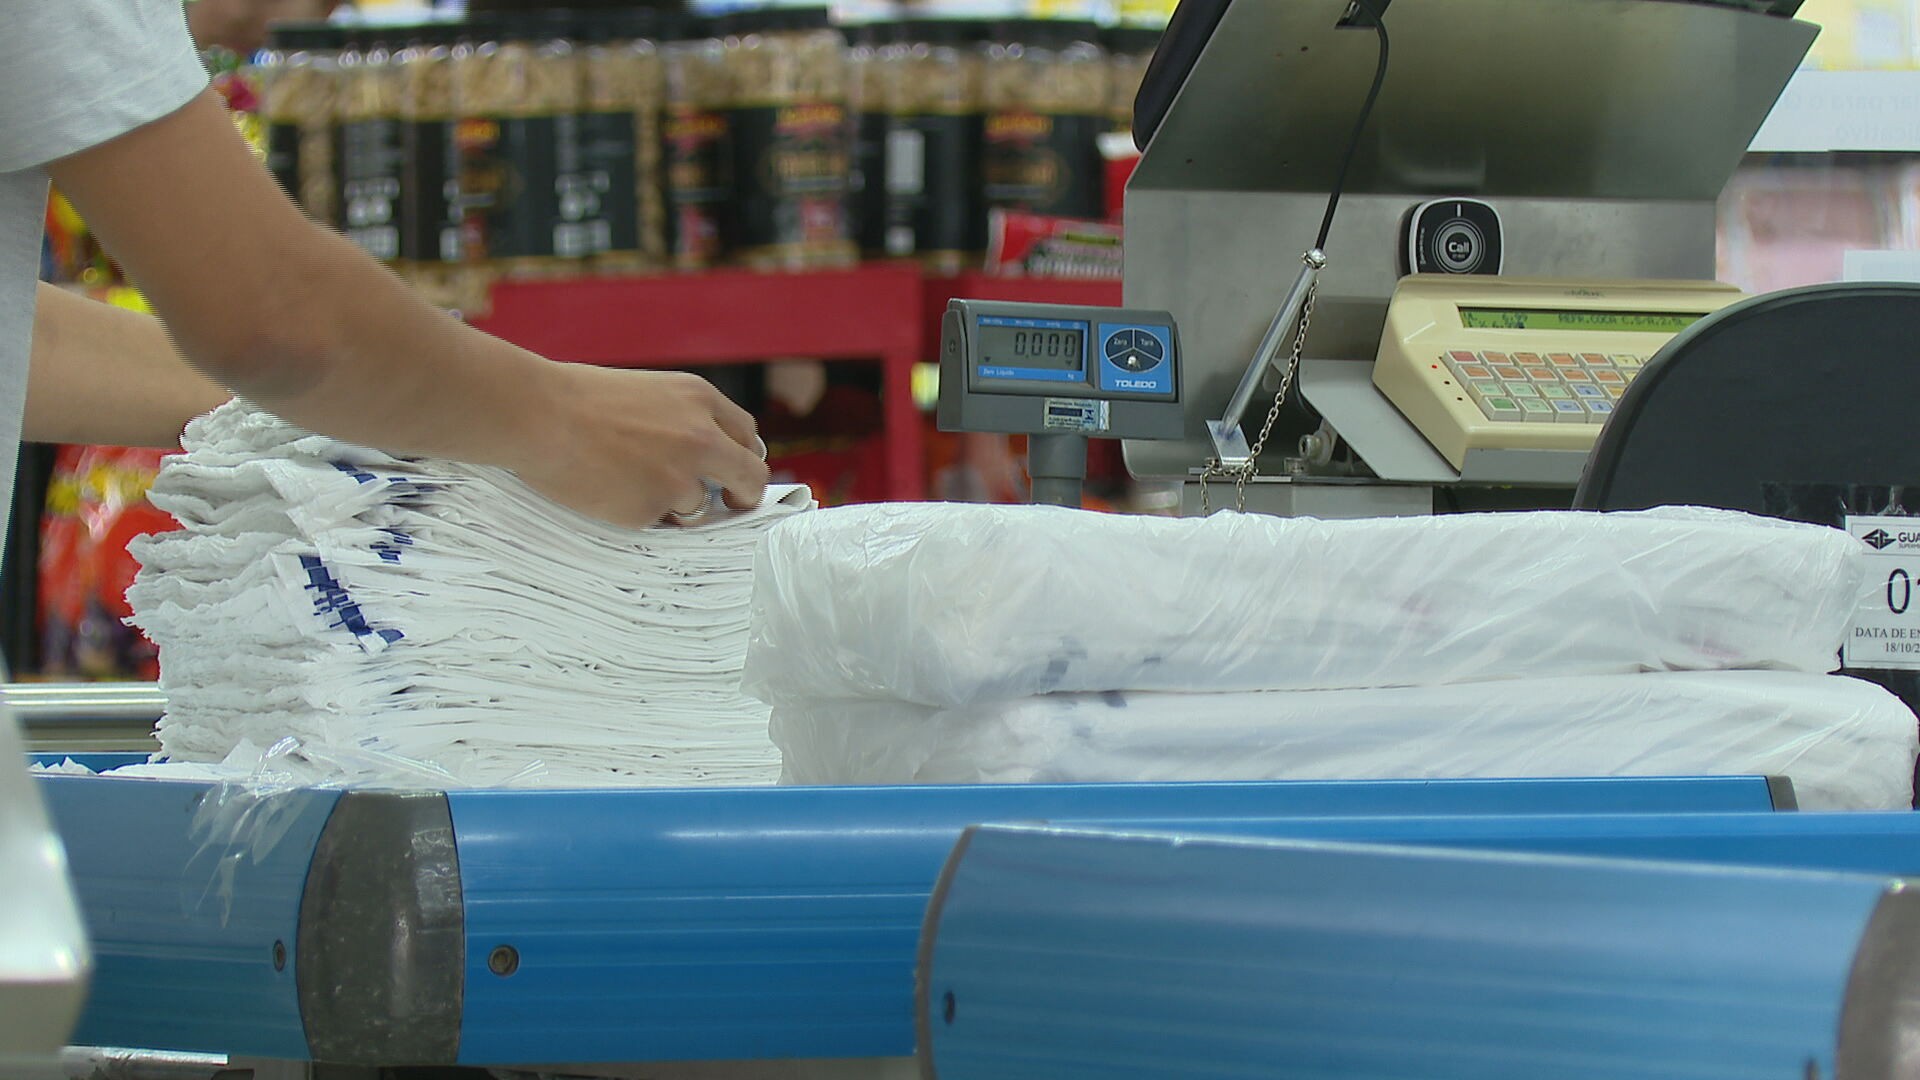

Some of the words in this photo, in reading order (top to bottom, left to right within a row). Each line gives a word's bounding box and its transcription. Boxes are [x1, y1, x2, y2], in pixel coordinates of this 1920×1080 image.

[1448, 241, 1470, 253] Call
[1115, 379, 1157, 389] TOLEDO
[1887, 568, 1920, 615] 0
[1855, 627, 1888, 639] DATA
[1891, 628, 1907, 639] DE
